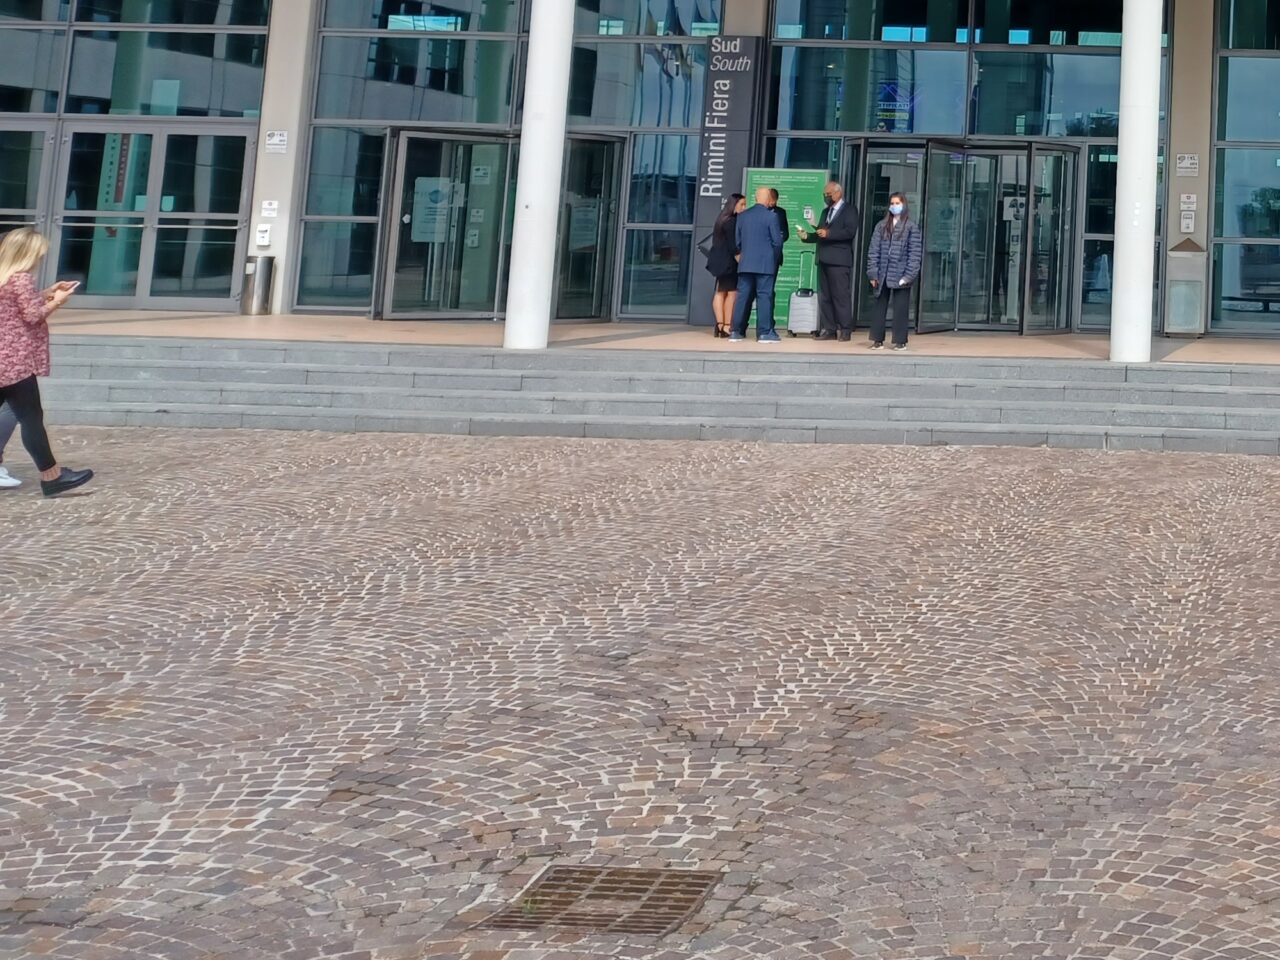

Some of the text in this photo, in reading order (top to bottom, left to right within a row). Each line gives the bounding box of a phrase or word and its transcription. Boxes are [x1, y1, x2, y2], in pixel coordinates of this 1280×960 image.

[711, 37, 740, 53] Sud
[710, 55, 751, 72] South
[700, 79, 730, 196] Rimini Fiera
